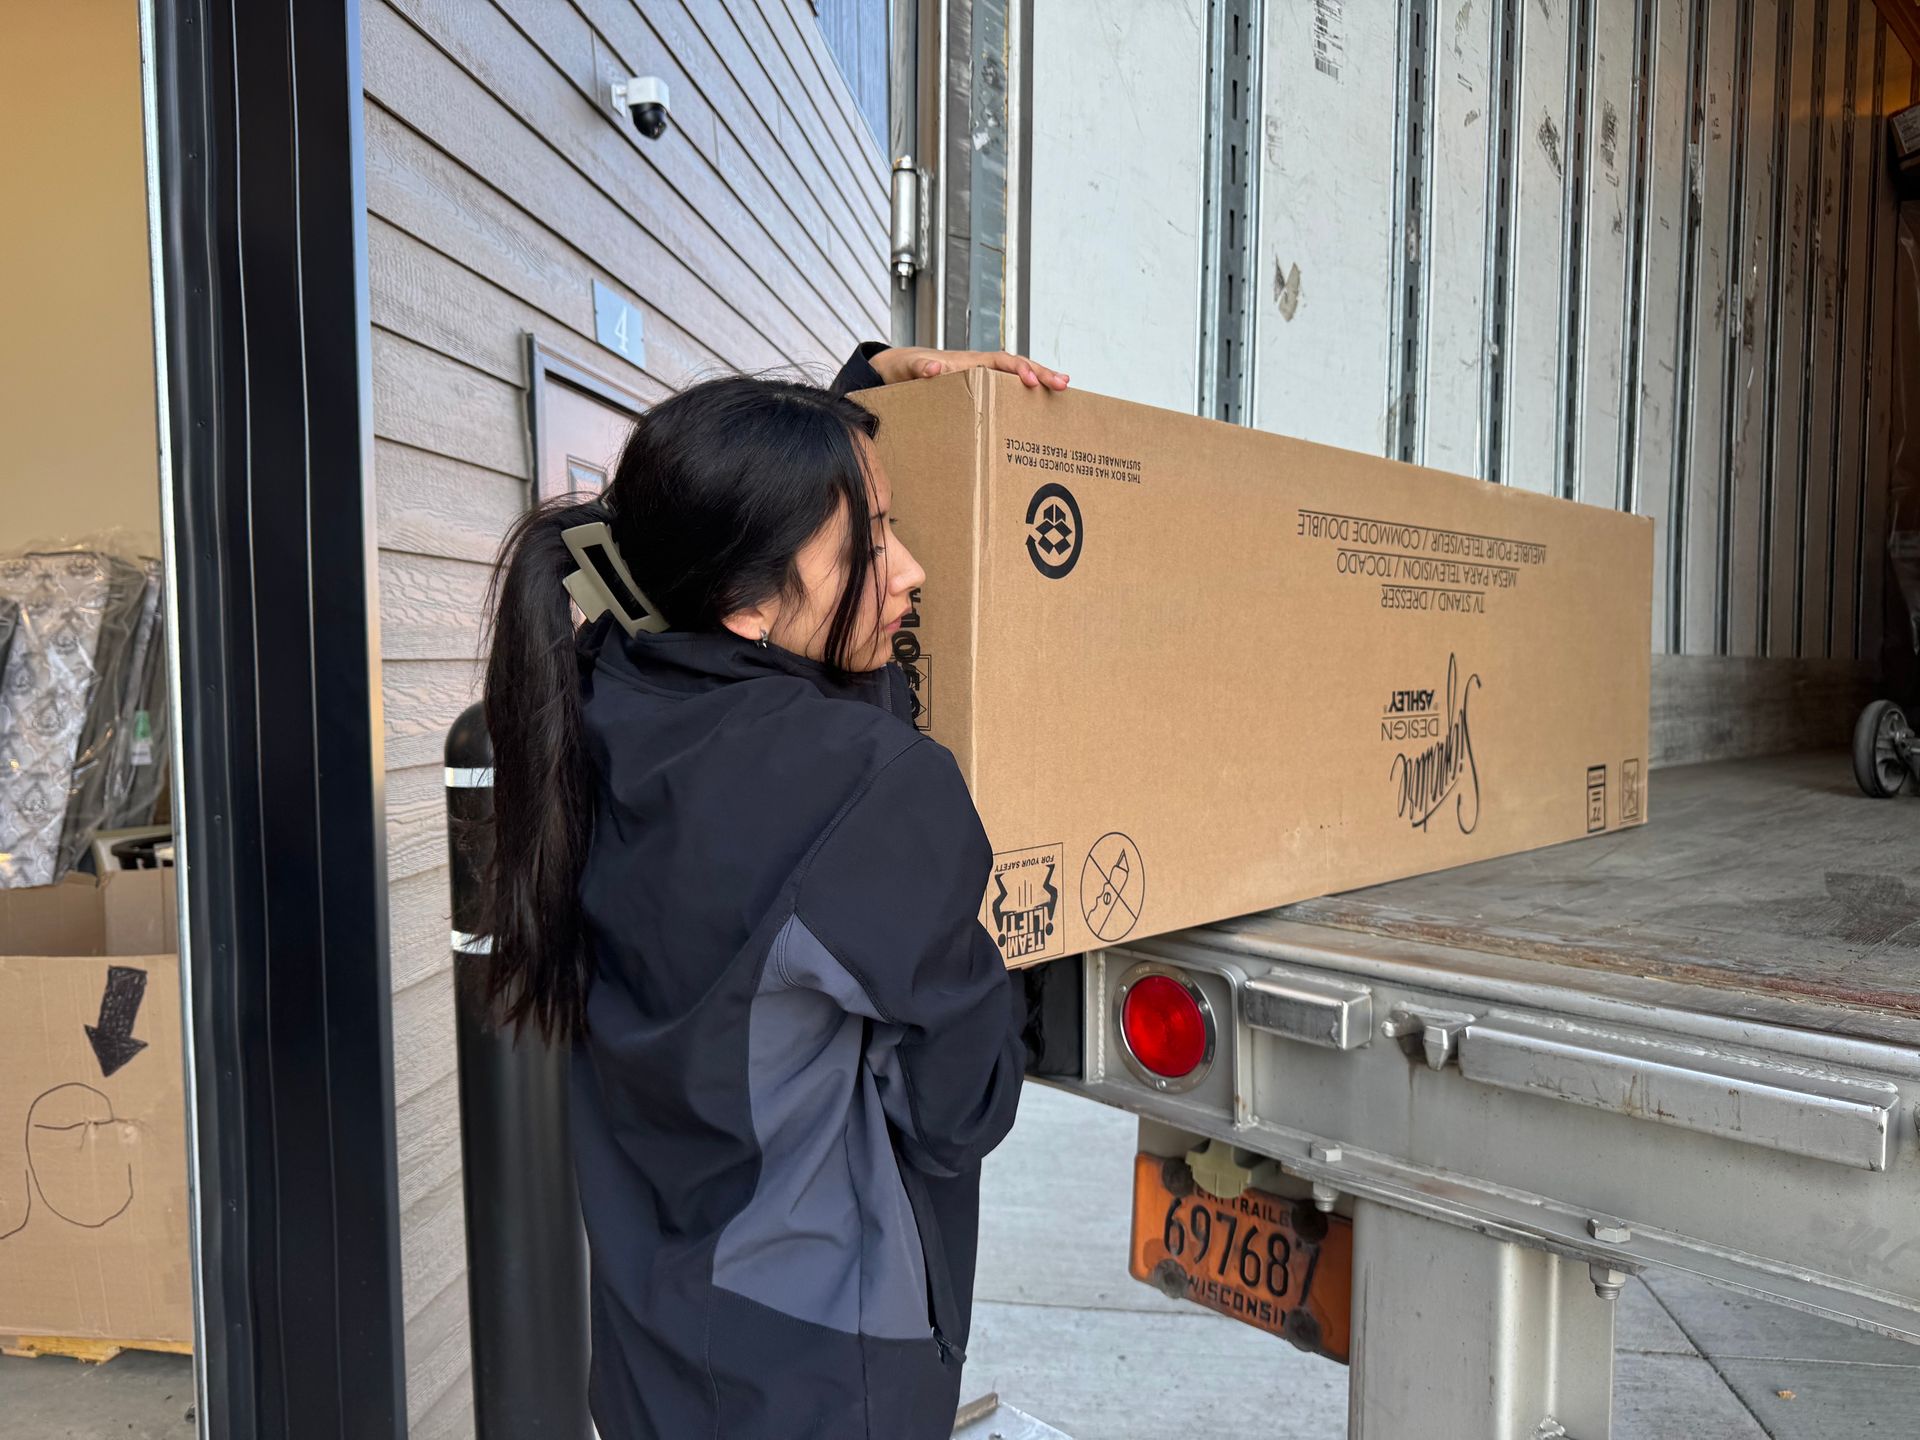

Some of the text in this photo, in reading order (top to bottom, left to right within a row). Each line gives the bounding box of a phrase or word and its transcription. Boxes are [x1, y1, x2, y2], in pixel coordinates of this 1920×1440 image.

[614, 306, 629, 354] 4
[1004, 438, 1141, 470] SUSTAINABLE FOREST. PLEASE RECYCLE.
[1007, 453, 1141, 484] THIS BOX HAS BEEN SOURCED FROM A
[1297, 514, 1546, 565] MEUBLE POUR TELEVISEUR / COMMODE DOUBLE
[1337, 552, 1517, 587] MESA PARA TELEVISION / TOCADO
[1381, 588, 1486, 614] TV STAND / DRESSER
[1389, 690, 1434, 712] ASHLEY
[1381, 718, 1440, 741] DESIGN
[1390, 652, 1482, 835] Signature
[994, 855, 1054, 873] FOR YOUR SAFETY
[1003, 907, 1044, 937] LIFT
[1007, 931, 1044, 958] TEAM
[1231, 1197, 1291, 1227] TRAILE
